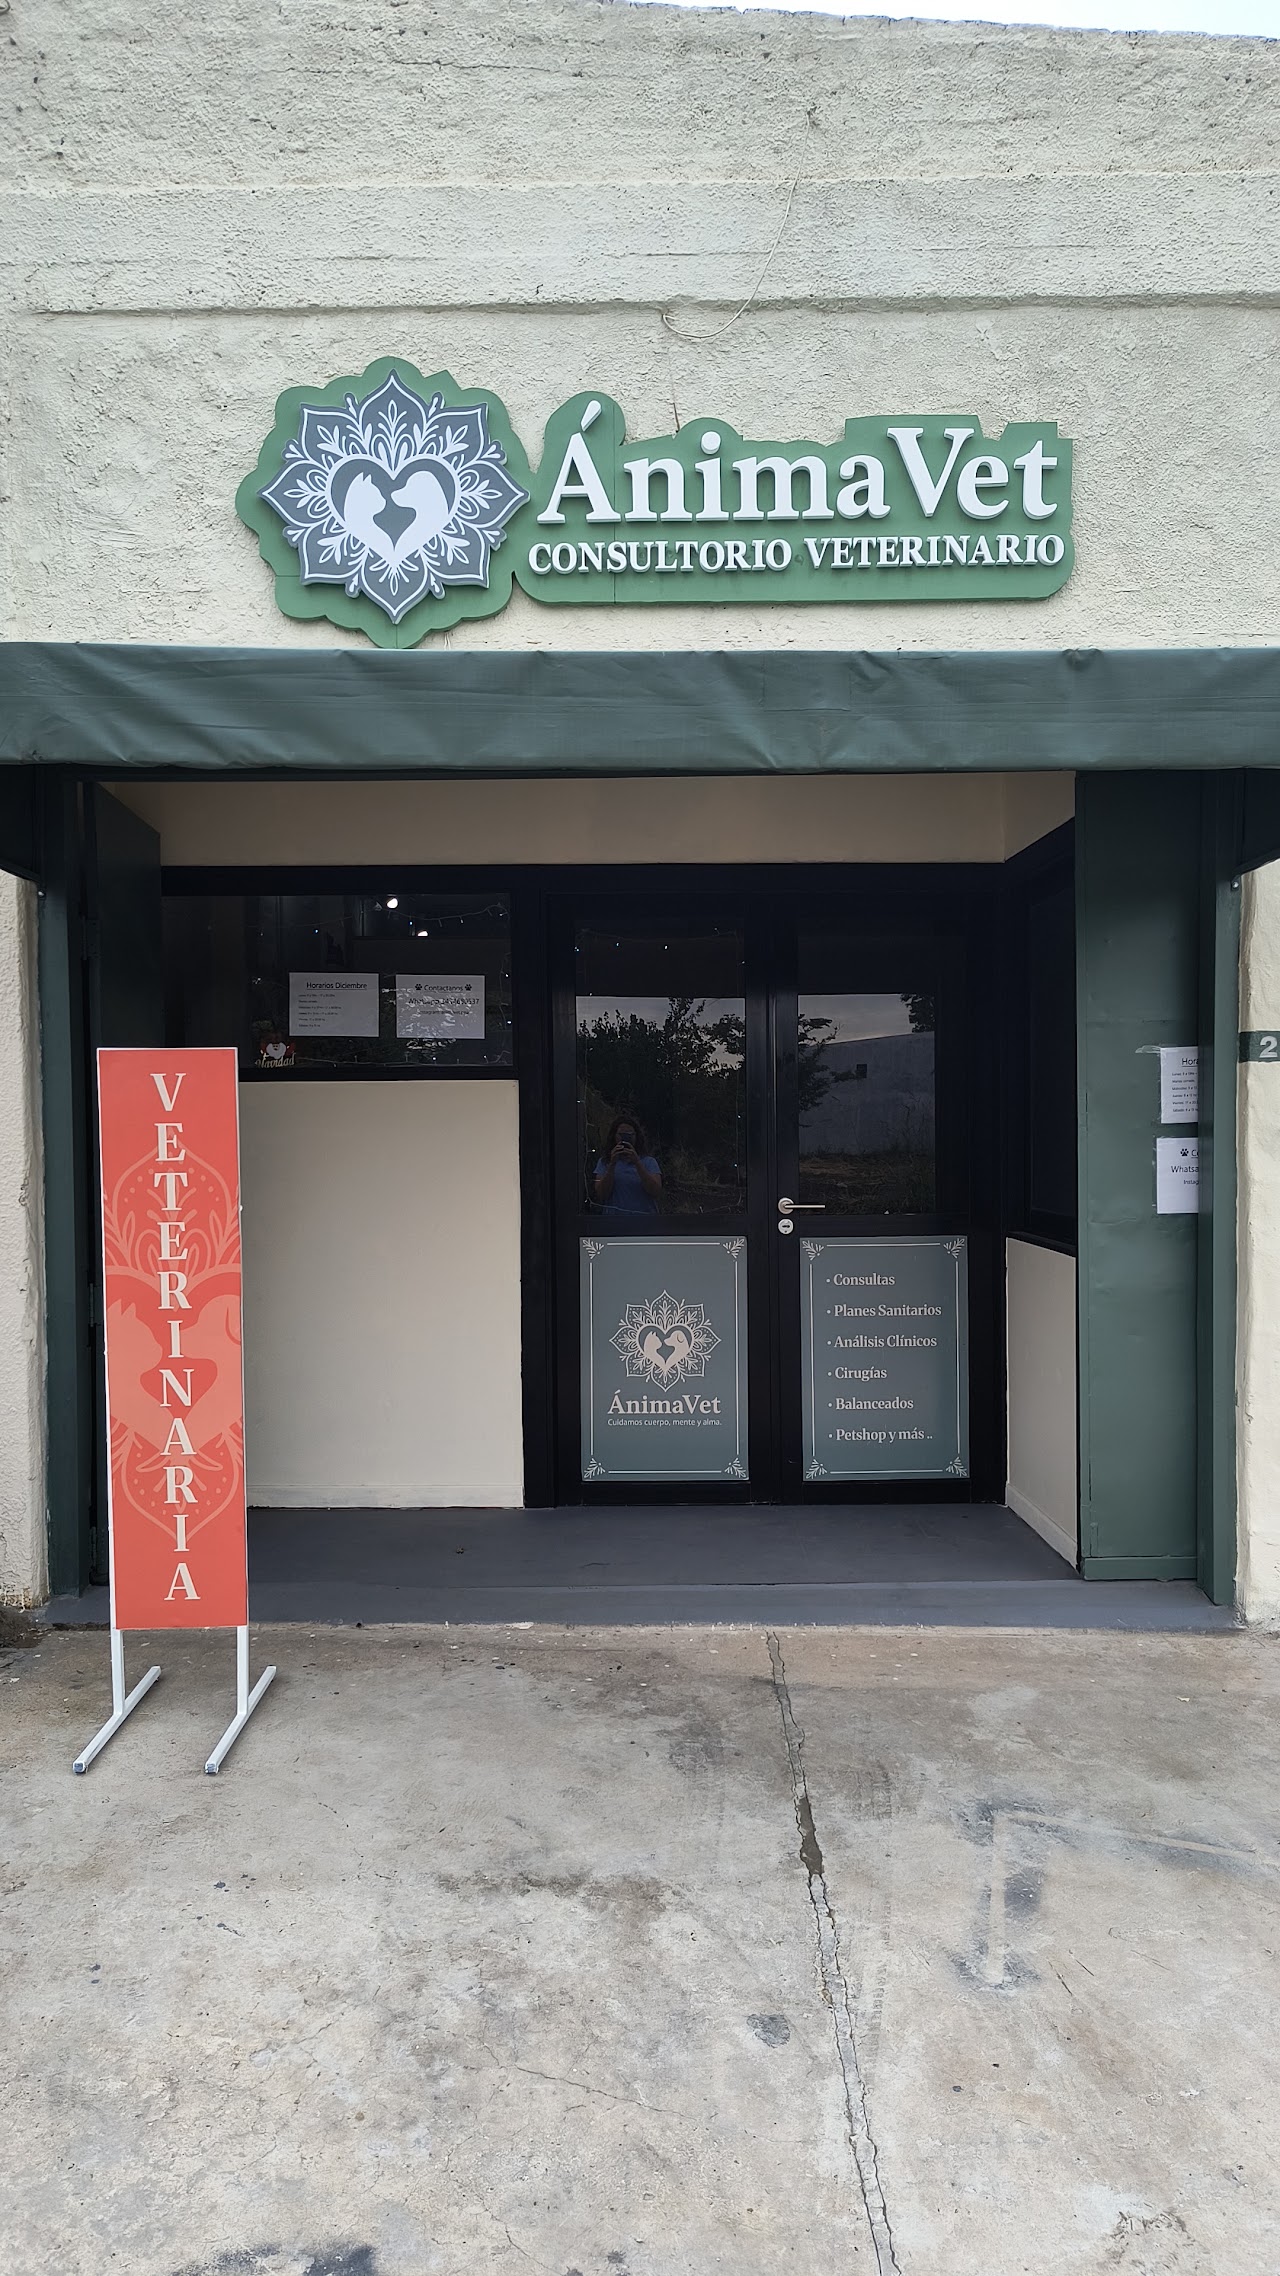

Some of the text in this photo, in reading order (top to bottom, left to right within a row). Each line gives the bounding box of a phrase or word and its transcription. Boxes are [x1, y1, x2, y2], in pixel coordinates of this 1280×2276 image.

[536, 400, 1058, 524] ÁnimaVet
[528, 534, 1065, 575] CONSULTORIO VETERINARIO
[1260, 1036, 1278, 1058] 2
[833, 1273, 895, 1286] Consultas
[834, 1304, 942, 1317] Planes Sanitarios
[149, 1072, 202, 1601] VETERINARIA
[834, 1335, 938, 1348] Análisis Clínicos
[835, 1366, 887, 1381] Cirugías
[607, 1389, 721, 1414] ÁnimaVet
[835, 1396, 914, 1410] Balanceados
[607, 1418, 643, 1427] Cuidamos
[644, 1419, 671, 1427] cuerpo,
[696, 1419, 701, 1427] y
[702, 1418, 722, 1426] alma.
[836, 1428, 887, 1443] Petshop
[888, 1431, 896, 1443] y
